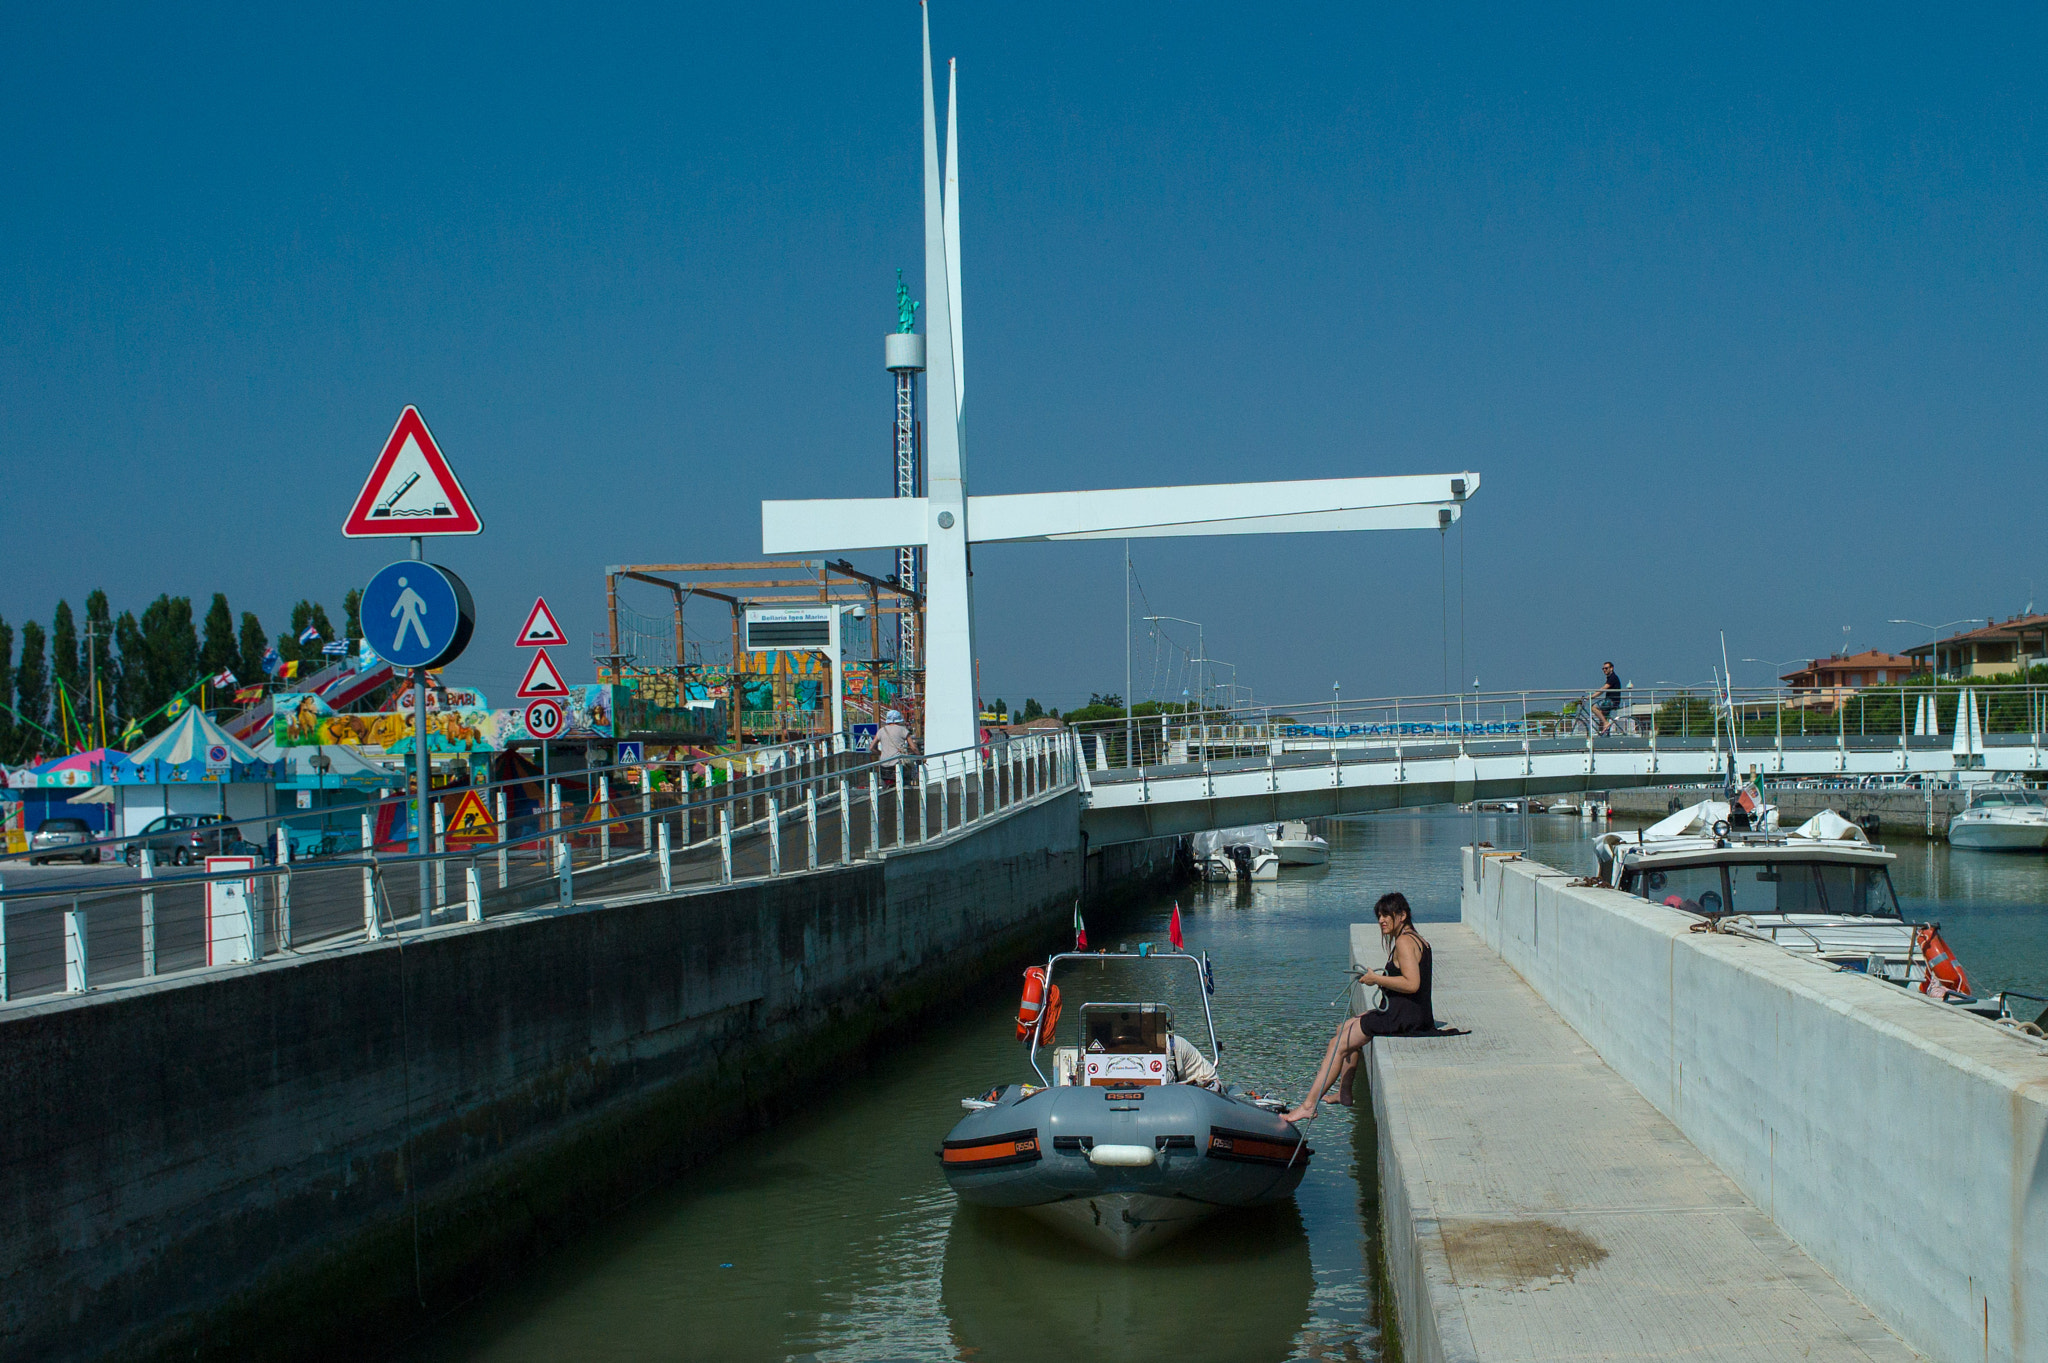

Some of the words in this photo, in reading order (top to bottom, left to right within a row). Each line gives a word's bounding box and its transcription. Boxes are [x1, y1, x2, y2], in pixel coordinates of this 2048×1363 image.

[788, 614, 804, 622] Igea
[532, 708, 556, 728] 30
[1286, 724, 1380, 737] BELLARIA
[1390, 723, 1435, 734] IGEA
[1443, 722, 1519, 734] MARINA
[1015, 1140, 1035, 1151] ASSO
